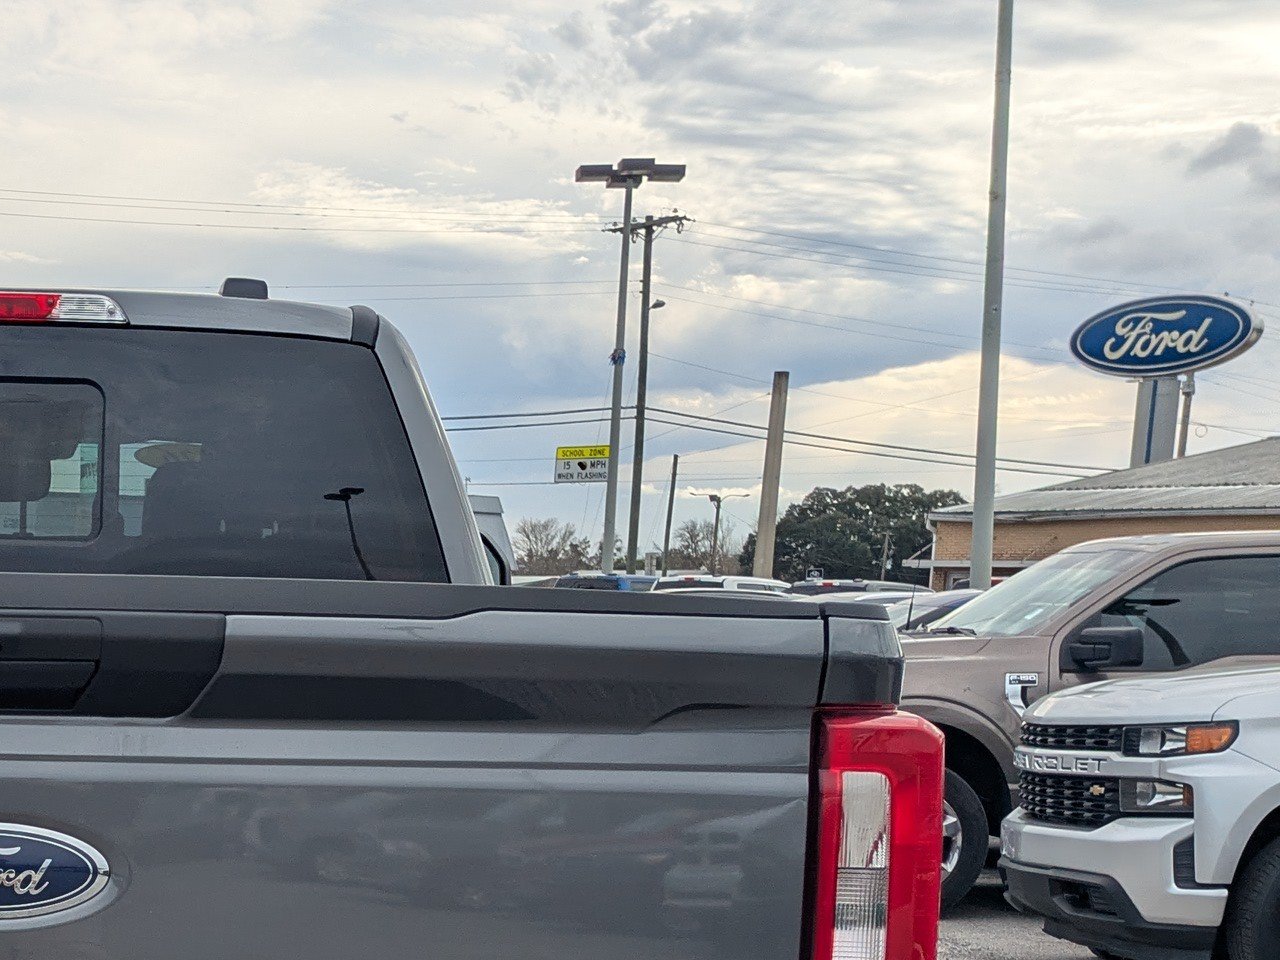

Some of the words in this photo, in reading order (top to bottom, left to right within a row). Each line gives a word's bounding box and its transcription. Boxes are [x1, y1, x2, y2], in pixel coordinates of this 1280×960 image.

[1103, 309, 1214, 361] Ford
[561, 449, 585, 458] SCHOOL
[588, 448, 607, 457] ZONE
[563, 461, 572, 470] 15
[589, 460, 607, 470] MPH
[557, 472, 575, 480] WHEN
[577, 471, 608, 480] FLASHING
